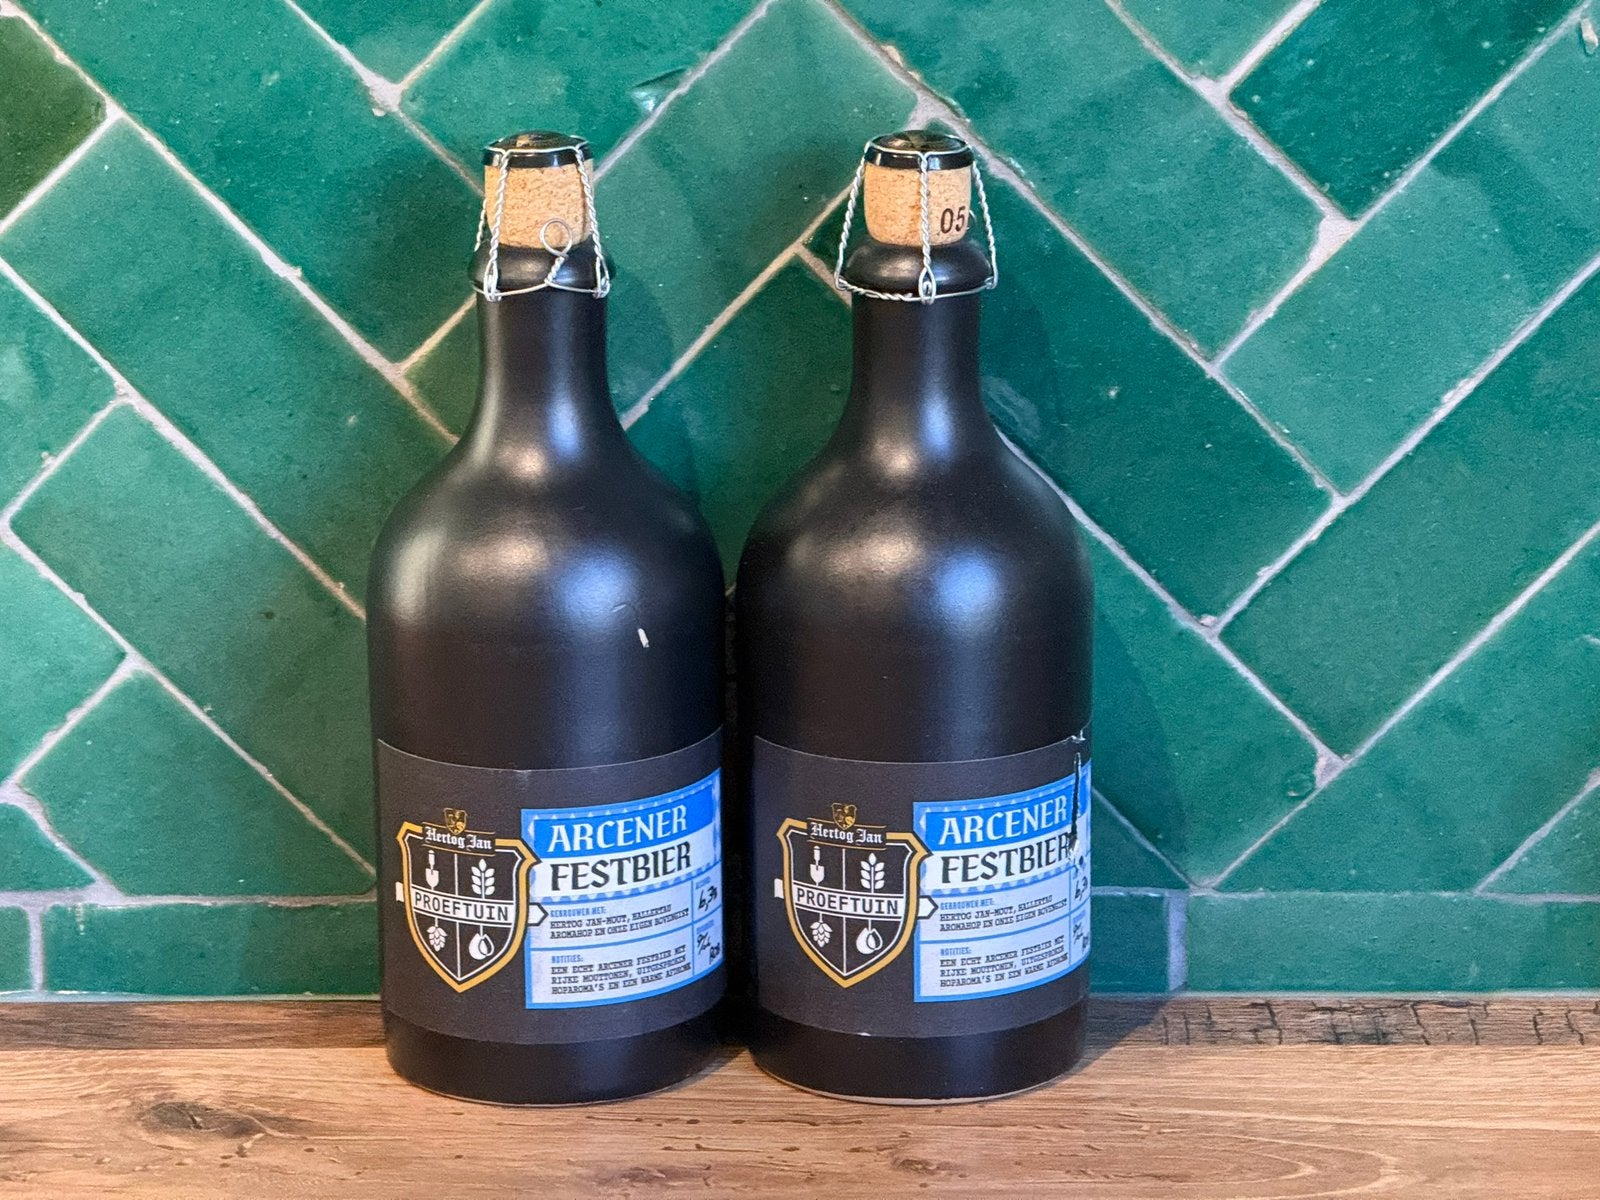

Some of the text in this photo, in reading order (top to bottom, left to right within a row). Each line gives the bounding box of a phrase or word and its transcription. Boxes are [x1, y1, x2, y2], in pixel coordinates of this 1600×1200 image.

[940, 206, 966, 234] 05
[939, 795, 1067, 845] ARCENER
[547, 804, 687, 853] ARCENER
[811, 823, 883, 845] Hertog Jan
[424, 827, 492, 852] Hertog Jan
[941, 832, 1071, 884] FESTBIER
[551, 841, 691, 892] FESTBIER
[415, 891, 508, 921] PROEFTUIN
[797, 888, 898, 915] PROEFTUIN
[550, 920, 582, 929] HERTOG
[940, 912, 971, 921] HERTOG
[550, 929, 592, 939] AROMAHOP
[594, 928, 605, 936] EN
[940, 921, 981, 931] AROMAHOP
[983, 920, 993, 928] EN
[551, 966, 568, 974] EEN
[572, 964, 594, 973] ECHT
[598, 959, 632, 971] ARCENER
[940, 959, 956, 967] EEN
[961, 957, 981, 966] ECHT
[986, 951, 1017, 963] ARCENER
[551, 976, 579, 984] RIJKE
[940, 968, 967, 977] RIJKE
[940, 975, 991, 987] HOPAROMA'S
[995, 973, 1004, 982] EN
[551, 984, 605, 994] HOPAROMA'S
[608, 981, 619, 990] EN
